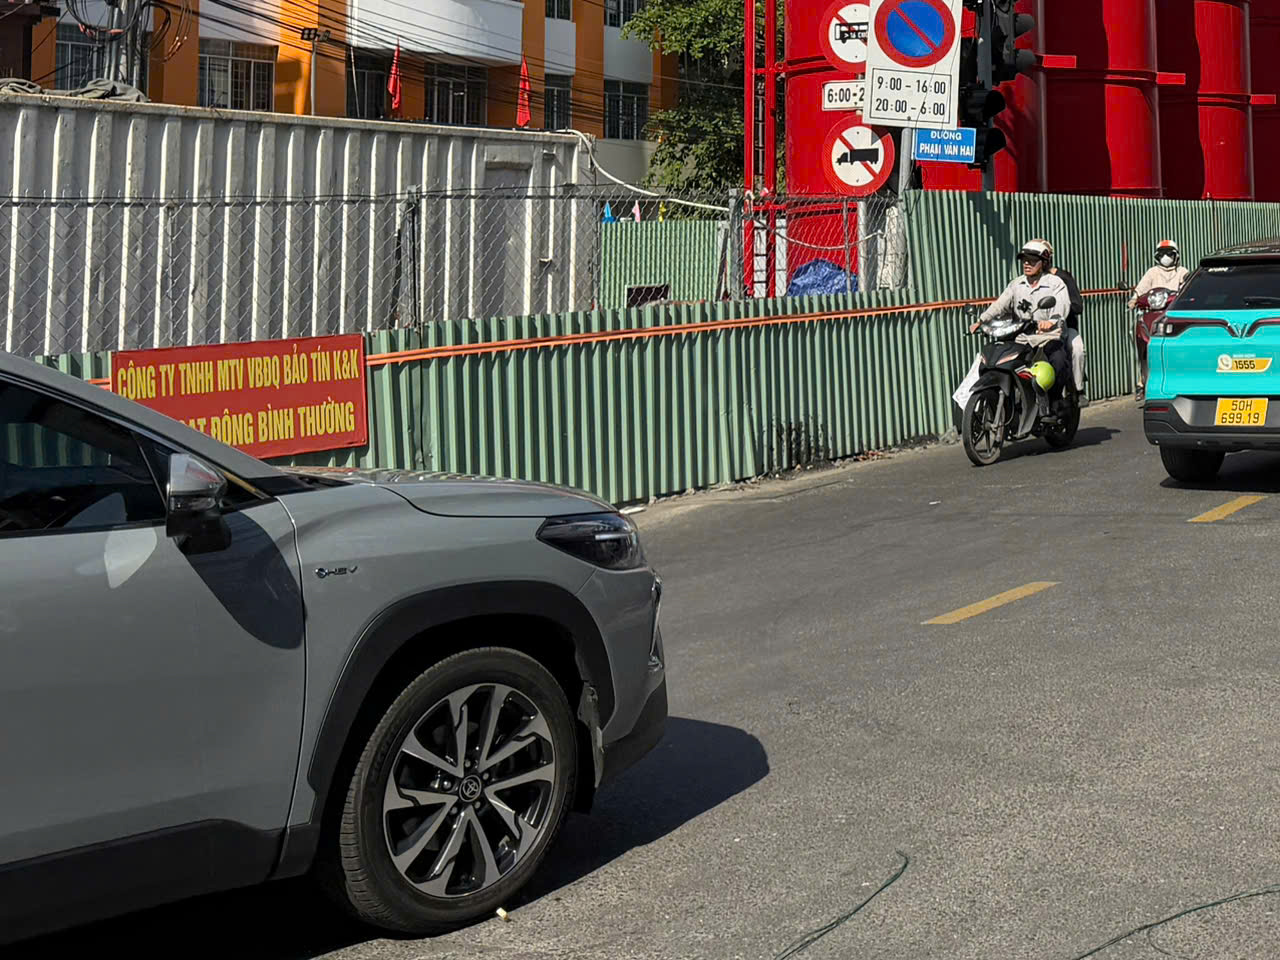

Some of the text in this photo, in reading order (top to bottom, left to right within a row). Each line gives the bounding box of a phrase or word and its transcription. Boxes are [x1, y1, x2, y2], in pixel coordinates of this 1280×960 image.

[877, 76, 902, 91] 9:00
[916, 79, 946, 94] 16:00
[875, 98, 907, 113] 20:00
[920, 101, 945, 116] 6:00
[920, 143, 941, 157] PHẠM
[960, 145, 973, 156] HAI
[117, 344, 360, 400] CÔNG TY TNHH MTV VBĐQ BẢO TÍN K&K
[1234, 360, 1256, 370] 1555
[1231, 400, 1253, 411] 50H
[258, 403, 295, 443] BÌNH
[297, 396, 356, 438] THƯỜNG
[1221, 412, 1260, 424] 699.19
